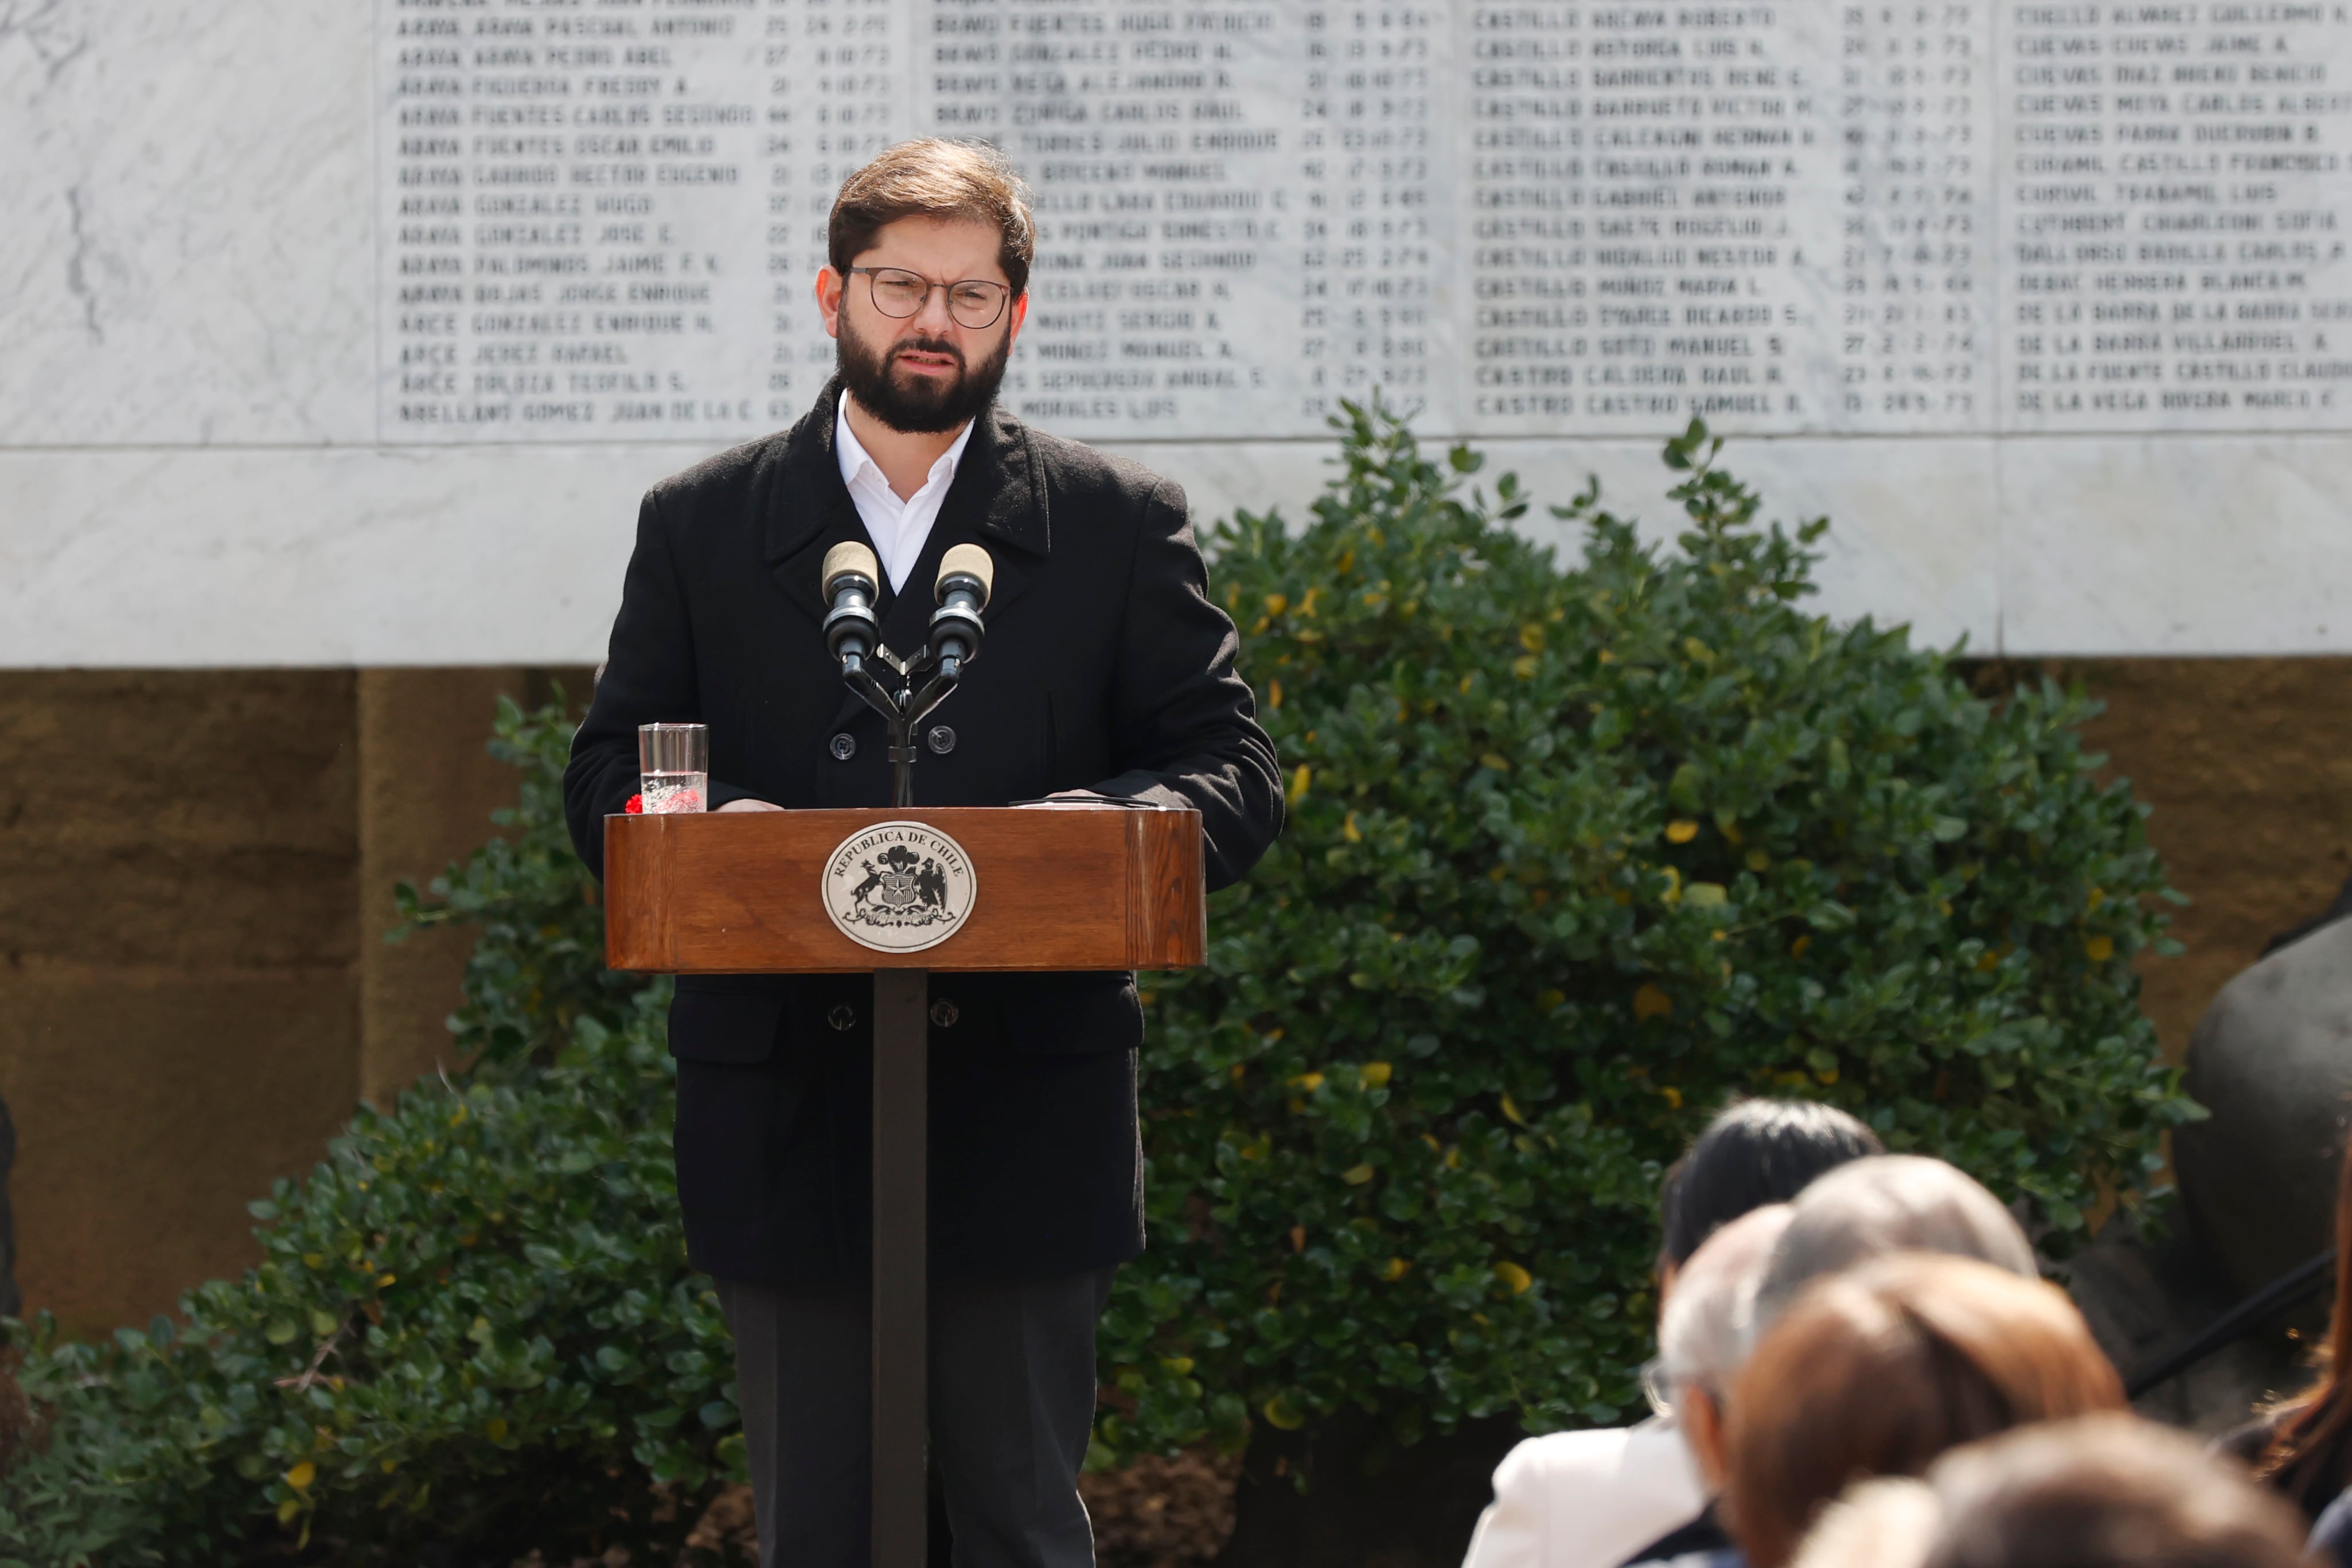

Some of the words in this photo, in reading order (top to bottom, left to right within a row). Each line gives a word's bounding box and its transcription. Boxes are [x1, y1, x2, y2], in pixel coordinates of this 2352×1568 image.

[397, 18, 462, 40] ARAYA
[474, 17, 535, 39] ARAYA
[931, 13, 999, 36] BRAVO
[1008, 13, 1106, 35] FUENTES
[1472, 9, 1579, 32] CASTILLO
[932, 42, 1001, 65] BRAVO
[1011, 42, 1121, 64] GONZALEZ
[1472, 38, 1580, 61] CASTILLO
[1694, 37, 1738, 59] LUIS
[2013, 34, 2101, 57] CUEVAS
[2111, 33, 2189, 56] CUEVAS
[397, 47, 463, 69] ARAYA
[472, 46, 535, 69] ARAYA
[932, 71, 1001, 93] BRAVO
[1472, 67, 1581, 89] CASTILLO
[2014, 63, 2101, 85] CUEVAS
[397, 76, 463, 97] ARAYA
[933, 102, 1001, 124] BRAVO
[1101, 100, 1181, 122] CARLOS
[1472, 97, 1581, 119] CASTILLO
[2014, 93, 2102, 115] CUEVAS
[2181, 92, 2265, 114] CARLOS
[397, 106, 462, 128] ARAYA
[471, 105, 565, 127] FUENTES
[574, 104, 653, 126] CARLOS
[1190, 130, 1281, 152] ENRIQUE
[1473, 127, 1582, 150] CASTILLO
[2014, 123, 2103, 146] CUEVAS
[397, 136, 462, 158] ARAYA
[472, 135, 565, 157] FUENTES
[1144, 159, 1223, 182] MANUEL
[1473, 157, 1583, 180] CASTILLO
[1592, 156, 1690, 178] CASTILLO
[2118, 152, 2220, 174] CASTILLO
[397, 165, 464, 188] ARAYA
[1473, 186, 1583, 209] CASTILLO
[2230, 181, 2277, 204] LUIS
[398, 195, 463, 217] ARAYA
[475, 194, 583, 217] GONZALEZ
[398, 224, 463, 246] ARAYA
[475, 223, 583, 245] GONZALEZ
[1474, 216, 1584, 238] CASTILLO
[1095, 249, 1150, 272] JUAN
[1475, 246, 1585, 269] CASTILLO
[2237, 241, 2318, 263] CARLOS
[398, 255, 464, 277] ARAYA
[398, 283, 465, 306] ARAYA
[627, 282, 711, 304] ENRIQUE
[1474, 275, 1585, 298] CASTILLO
[398, 313, 457, 336] ARCE
[471, 313, 582, 335] GONZALEZ
[593, 311, 685, 334] ENRIQUE
[1475, 305, 1586, 327] CASTILLO
[399, 344, 458, 366] ARCE
[1121, 339, 1204, 361] MANUEL
[1473, 336, 1586, 358] CASTILLO
[1666, 335, 1752, 357] MANUEL
[1475, 364, 1572, 387] CASTRO
[2174, 359, 2270, 381] CASTILLO
[399, 372, 458, 394] ARCE
[609, 400, 665, 422] JUAN
[1128, 396, 1178, 419] LUIS
[1475, 393, 1573, 416] CASTRO
[1585, 393, 1678, 415] CASTRO
[833, 831, 904, 878] REPUBLICA
[908, 832, 927, 845] DE
[930, 840, 965, 877] CHILE
